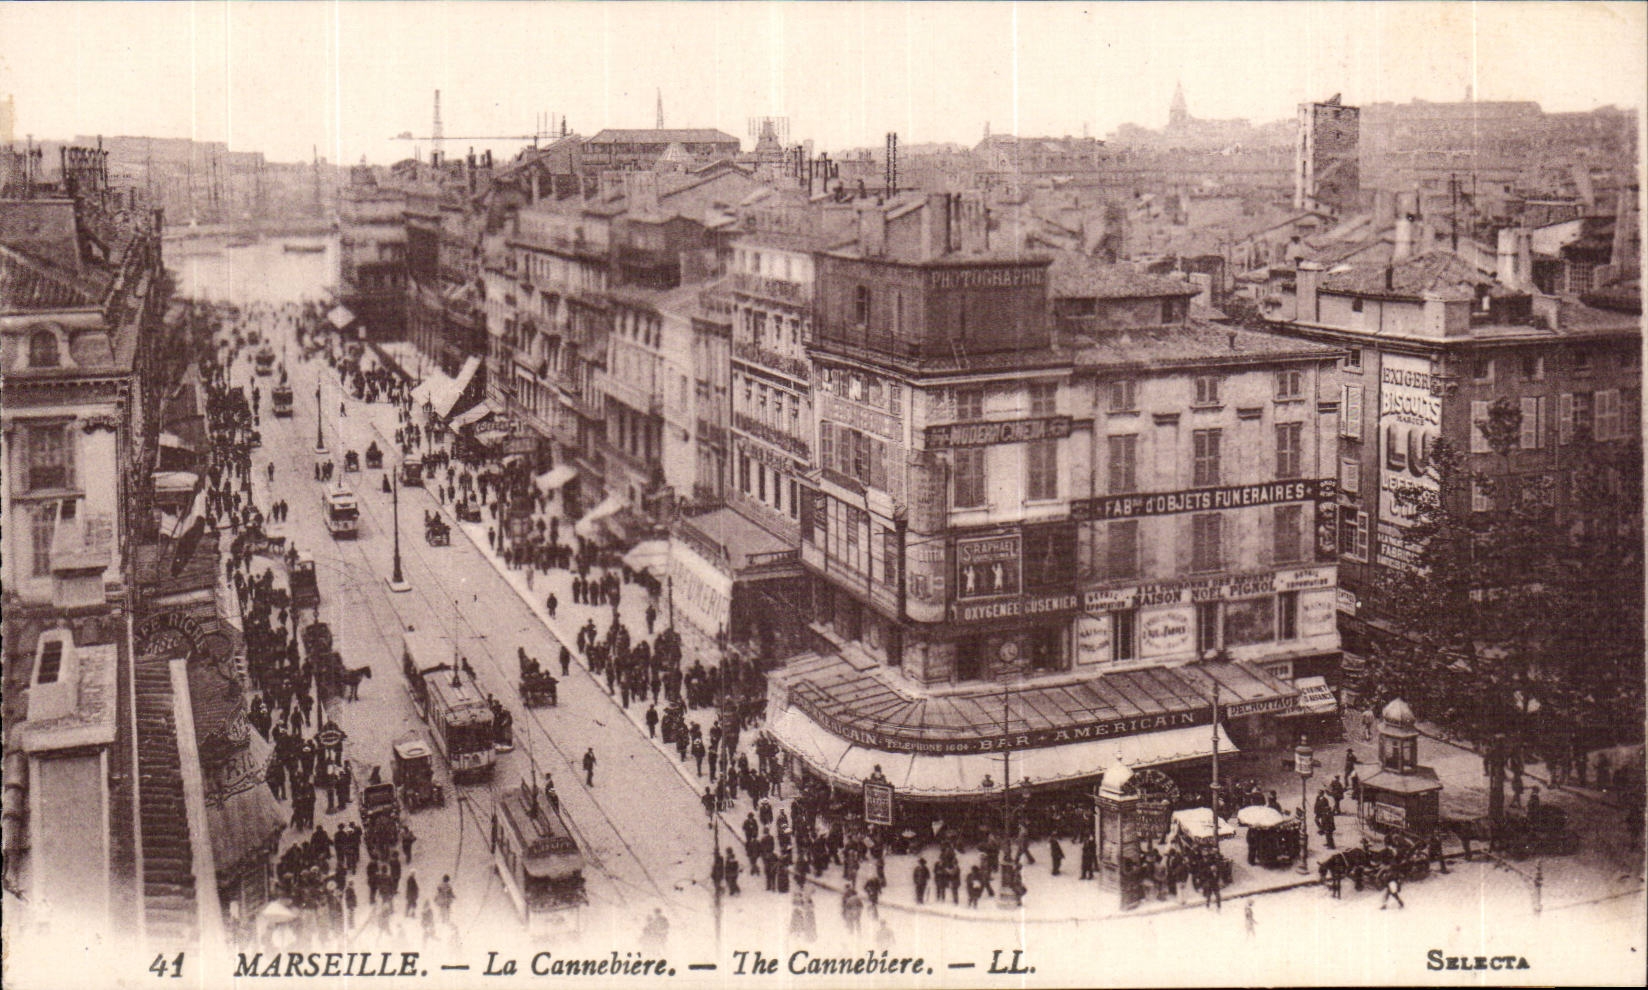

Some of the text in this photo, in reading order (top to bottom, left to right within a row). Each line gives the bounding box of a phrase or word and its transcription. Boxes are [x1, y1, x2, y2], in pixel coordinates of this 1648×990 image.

[1382, 367, 1431, 390] EXIGER
[1382, 393, 1441, 426] BISCUITS
[1386, 423, 1434, 478] LU
[1131, 591, 1182, 607] MAISON
[1230, 581, 1277, 597] PIGNOL
[979, 712, 1196, 750] BAR AMERICAIN
